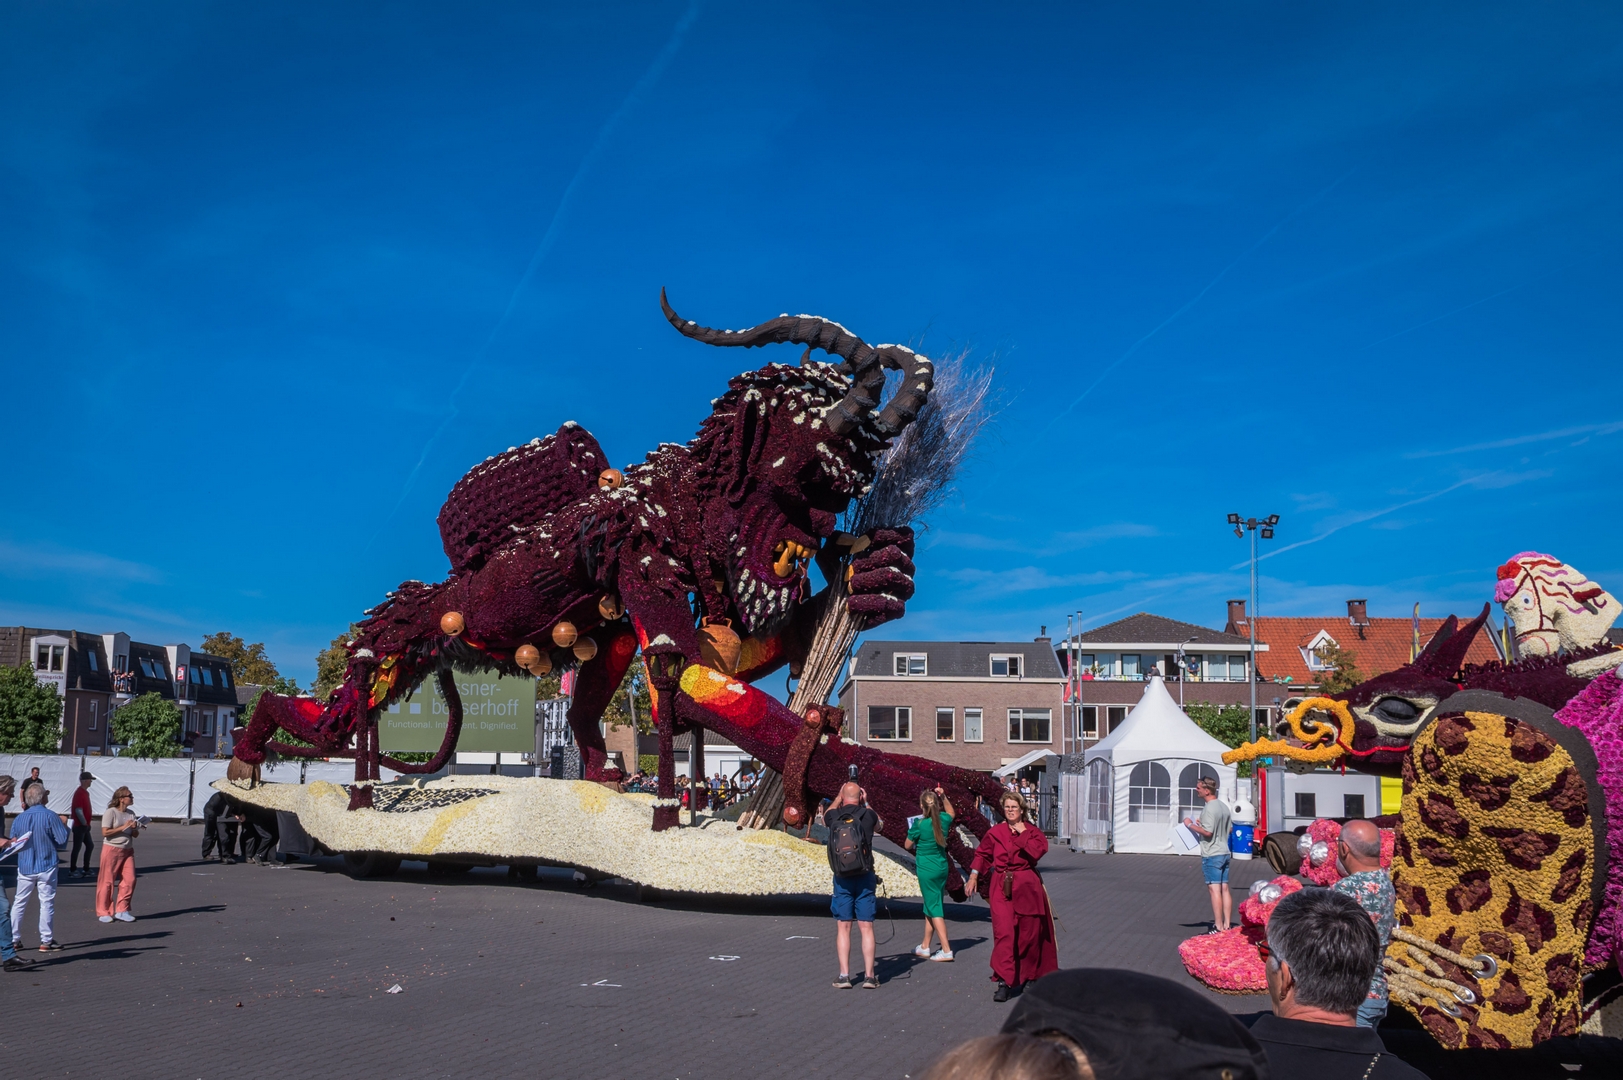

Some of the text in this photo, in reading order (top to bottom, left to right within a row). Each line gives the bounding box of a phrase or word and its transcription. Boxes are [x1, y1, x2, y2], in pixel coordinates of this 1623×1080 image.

[433, 682, 501, 696] ssner-
[432, 698, 519, 716] boserhoff
[388, 720, 519, 731] Functional. Intent. Dignified.
